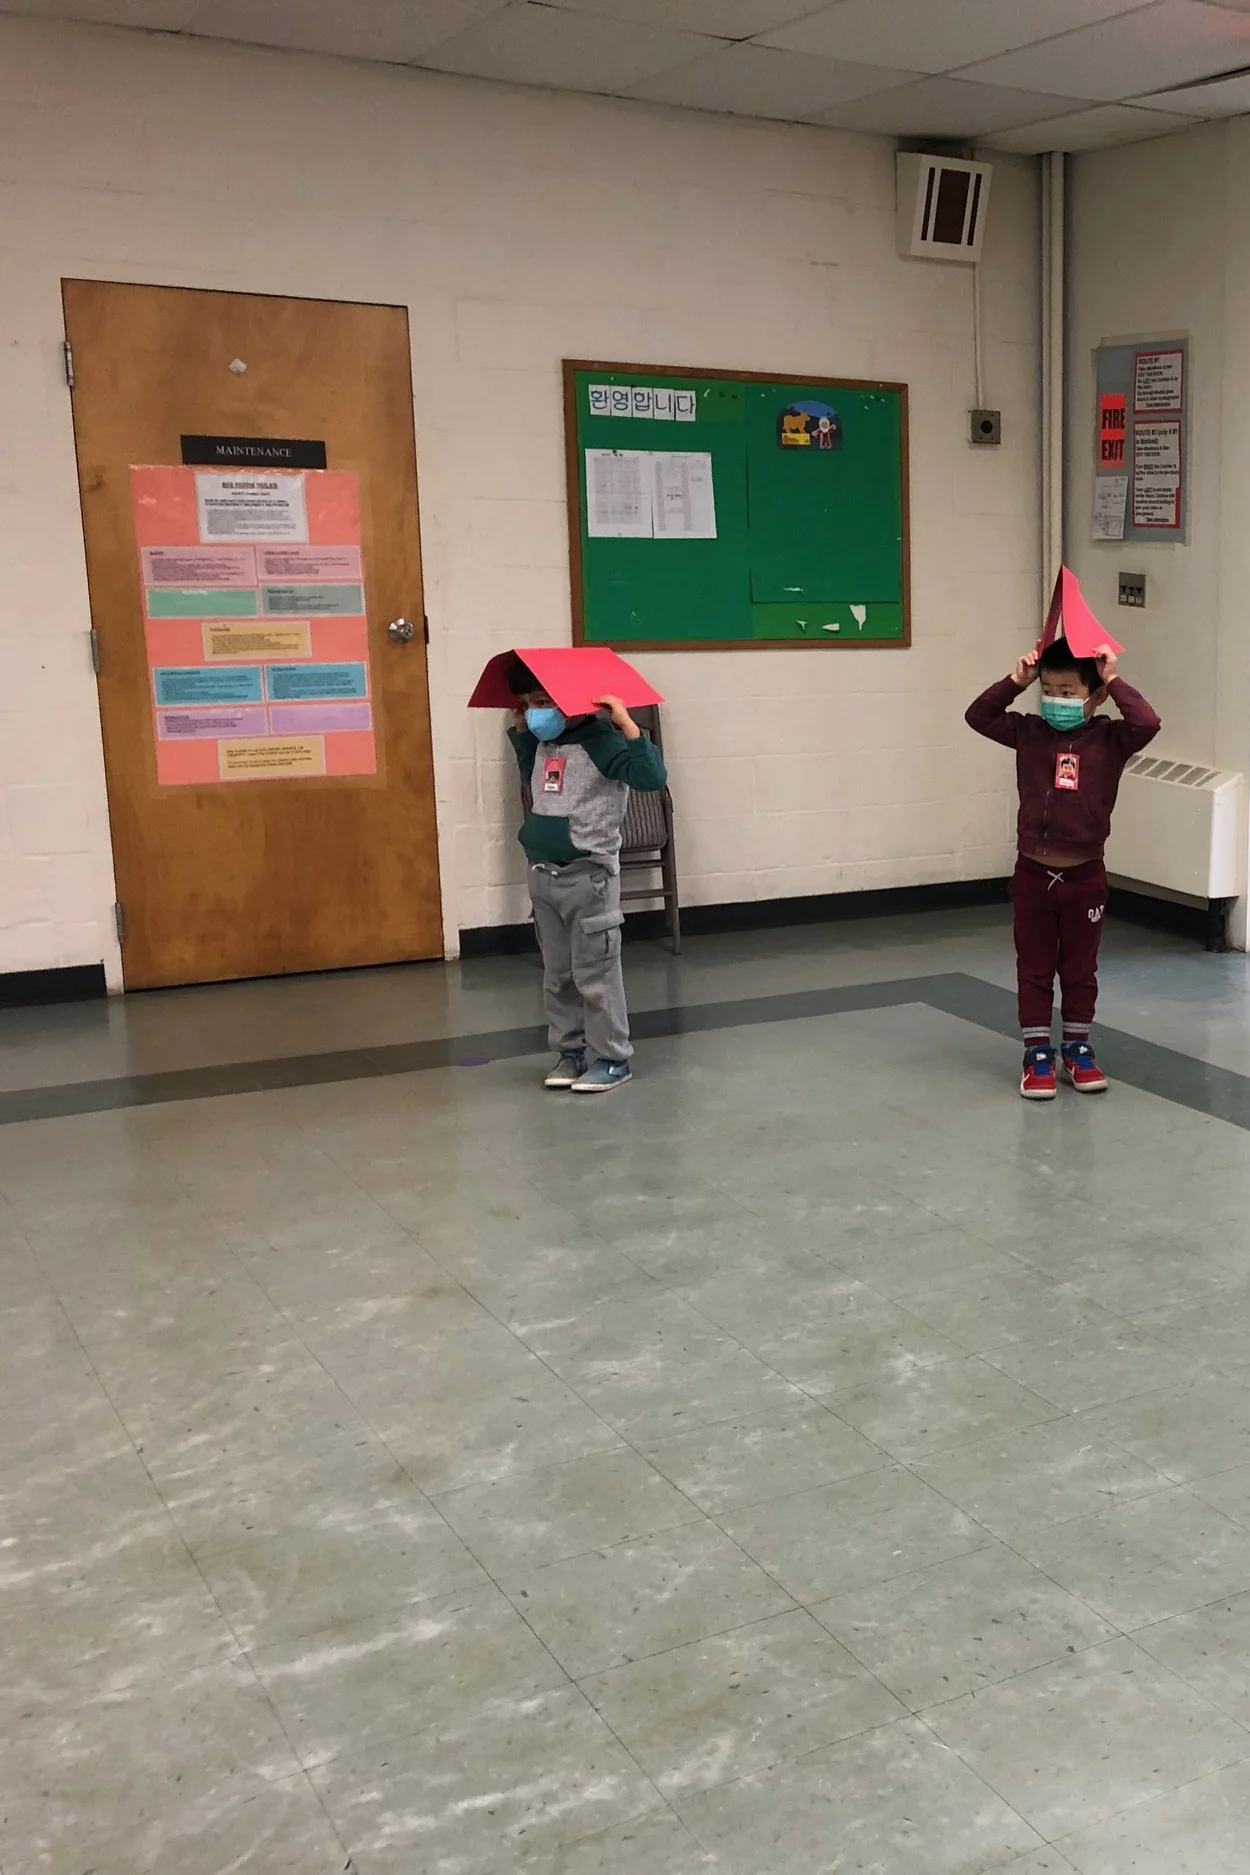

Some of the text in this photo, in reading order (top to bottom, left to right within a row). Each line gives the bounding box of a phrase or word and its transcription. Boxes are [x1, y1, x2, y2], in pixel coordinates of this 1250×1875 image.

[591, 389, 695, 414] 환영합니다
[1102, 408, 1125, 429] FIRE
[216, 445, 292, 457] MAINTENANCE
[1101, 440, 1124, 460] EXIT
